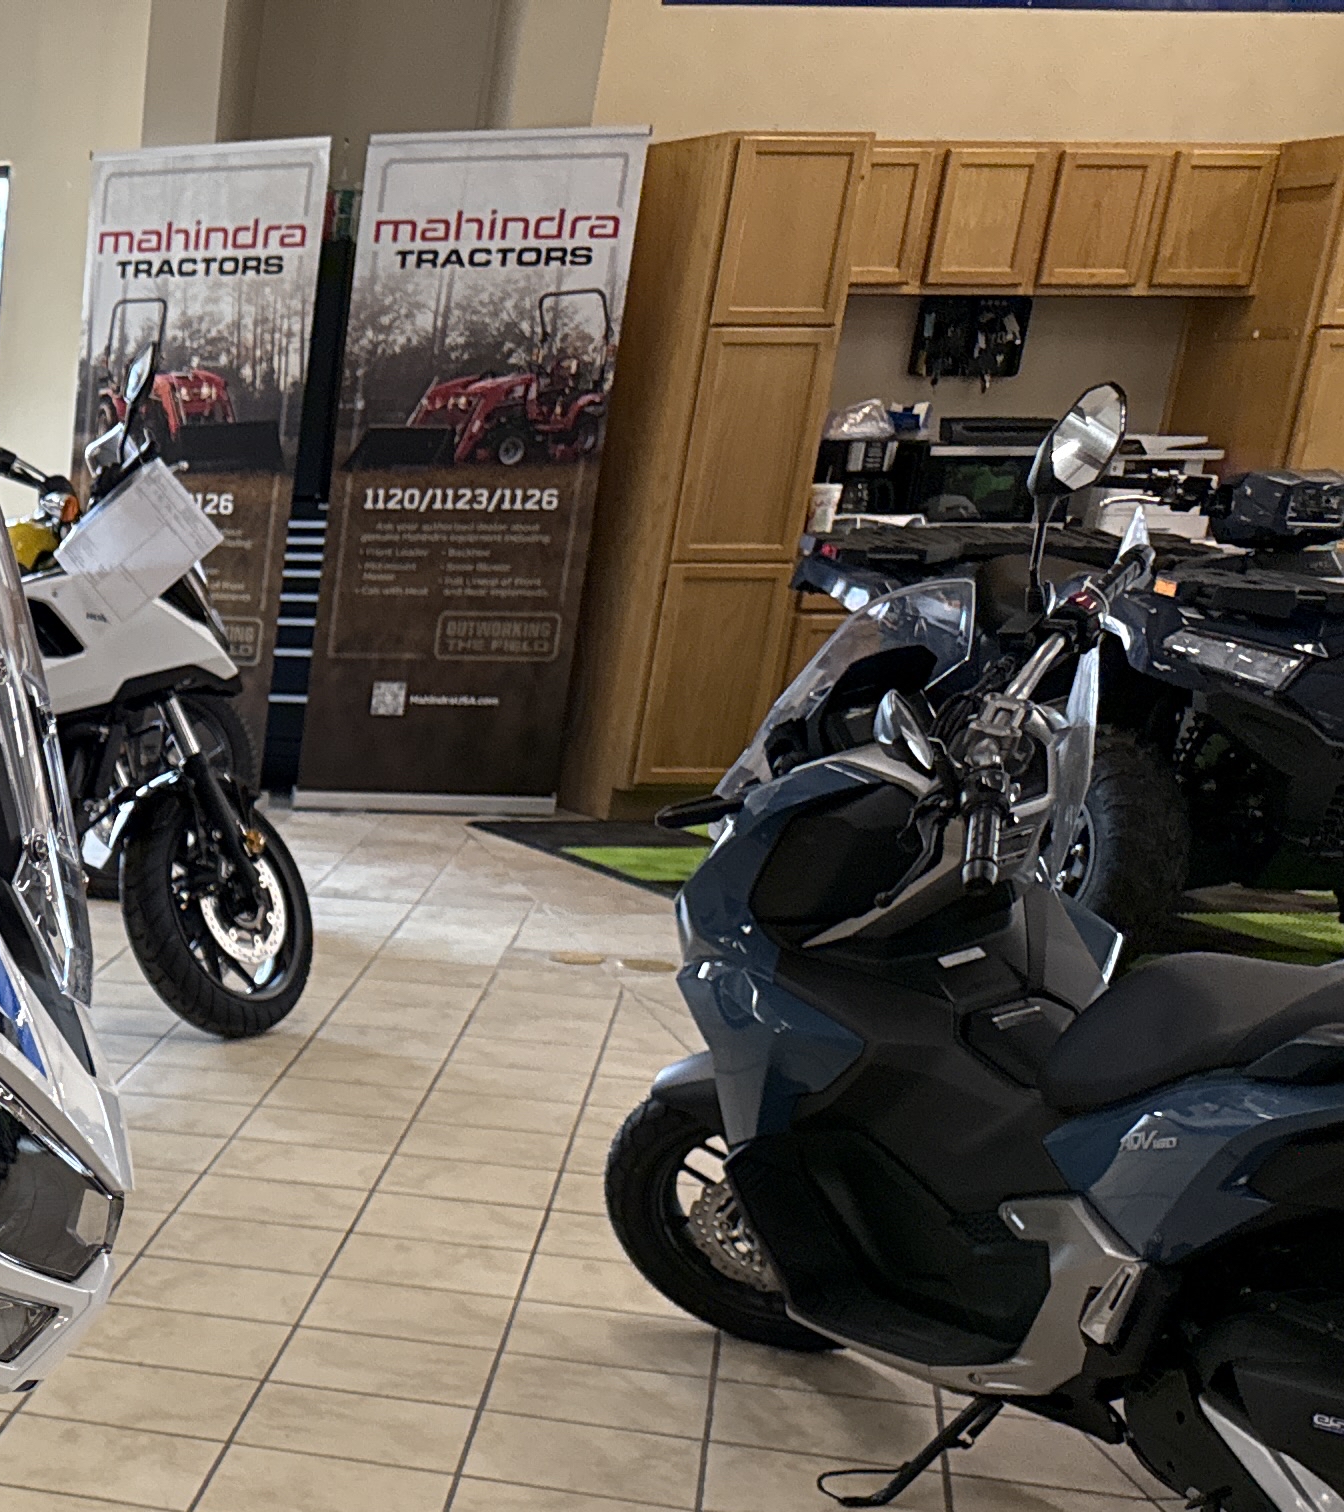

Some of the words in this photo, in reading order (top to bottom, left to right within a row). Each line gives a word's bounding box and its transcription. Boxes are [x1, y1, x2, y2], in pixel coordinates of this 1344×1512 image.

[97, 216, 308, 255] mahindra
[373, 207, 622, 244] mahindra
[116, 254, 285, 279] TRACTORS
[395, 245, 594, 269] TRACTORS
[363, 487, 559, 513] 1120/1123/1126
[445, 619, 551, 638] OUTWORKING
[446, 640, 485, 652] THE
[490, 640, 551, 653] FIELD
